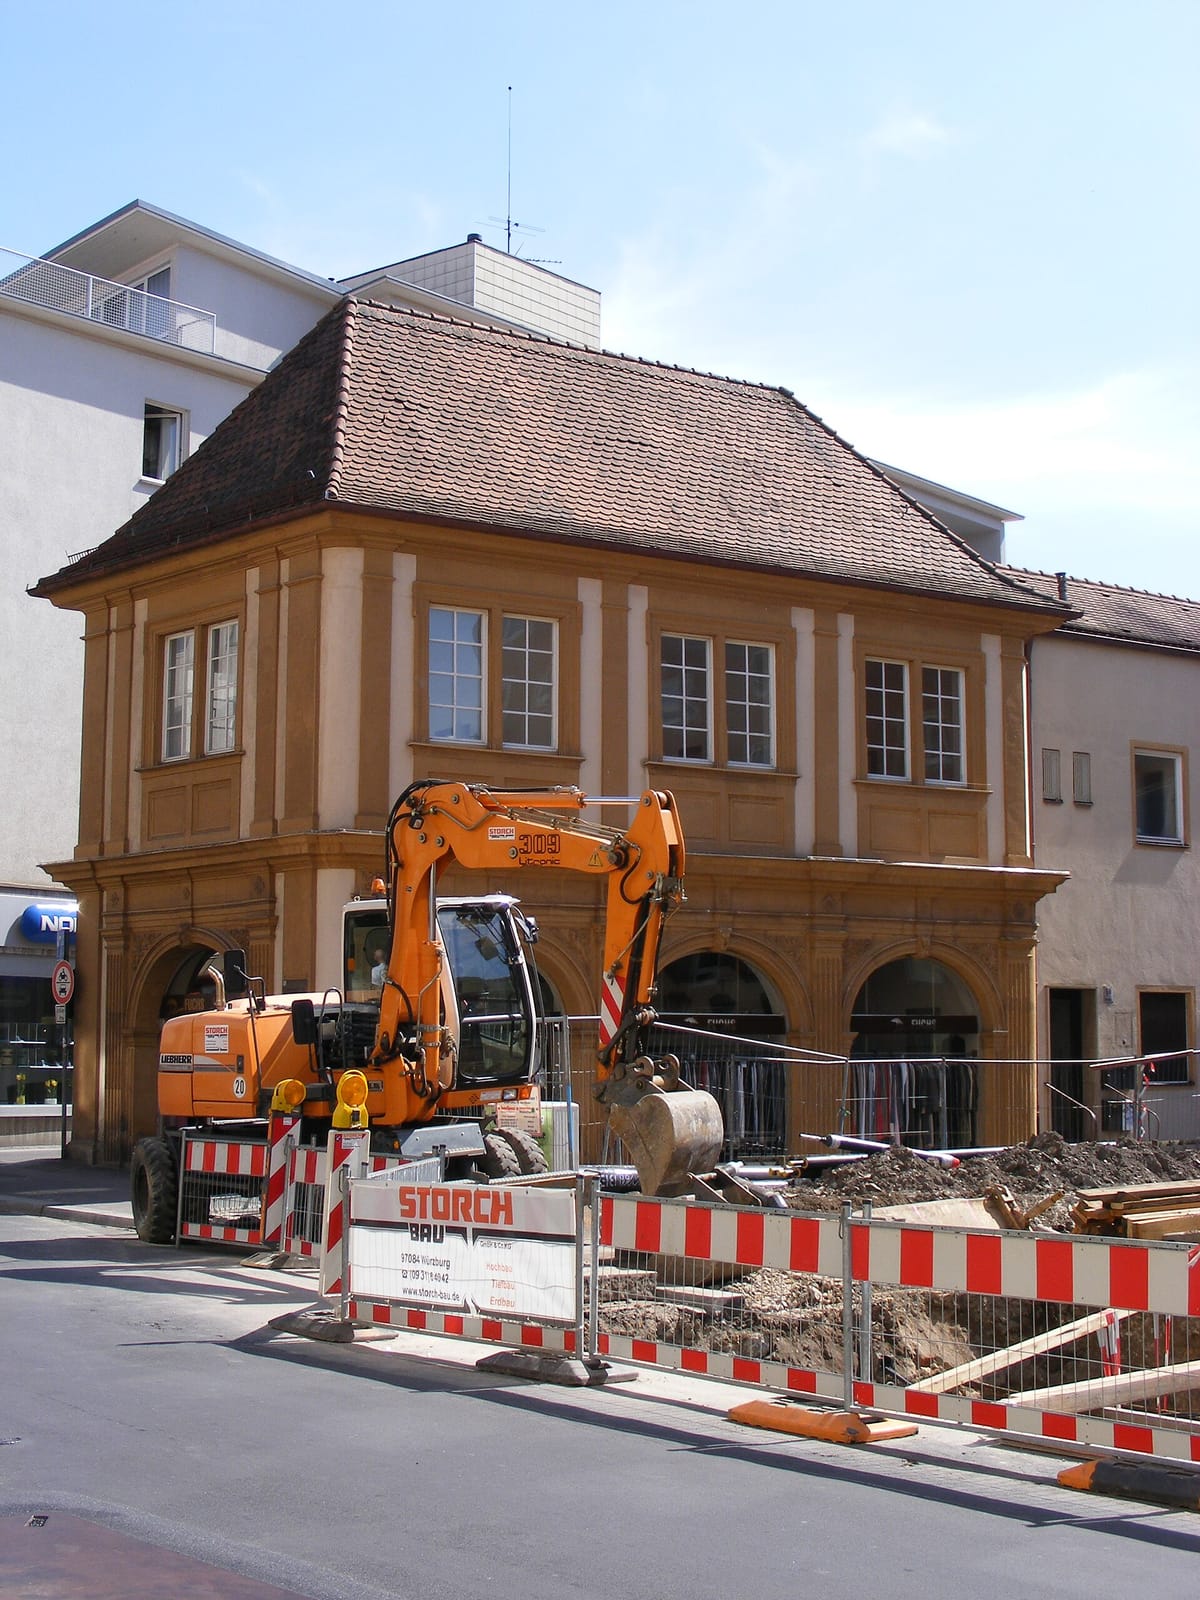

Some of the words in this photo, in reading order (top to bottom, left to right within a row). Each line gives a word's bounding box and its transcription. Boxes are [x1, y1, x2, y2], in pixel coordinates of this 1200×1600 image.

[519, 834, 560, 854] 309
[519, 856, 560, 865] Litronic
[205, 1026, 228, 1034] STORCH
[161, 1055, 192, 1064] LIEBHERR
[235, 1079, 245, 1095] 20
[399, 1186, 513, 1225] STORCH
[410, 1224, 444, 1243] BAU
[401, 1253, 420, 1264] 97084
[421, 1255, 451, 1270] Würzburg
[492, 1279, 515, 1290] Tiefbau
[402, 1287, 460, 1302] www.storch-bau.de
[490, 1296, 515, 1307] Erdbau
